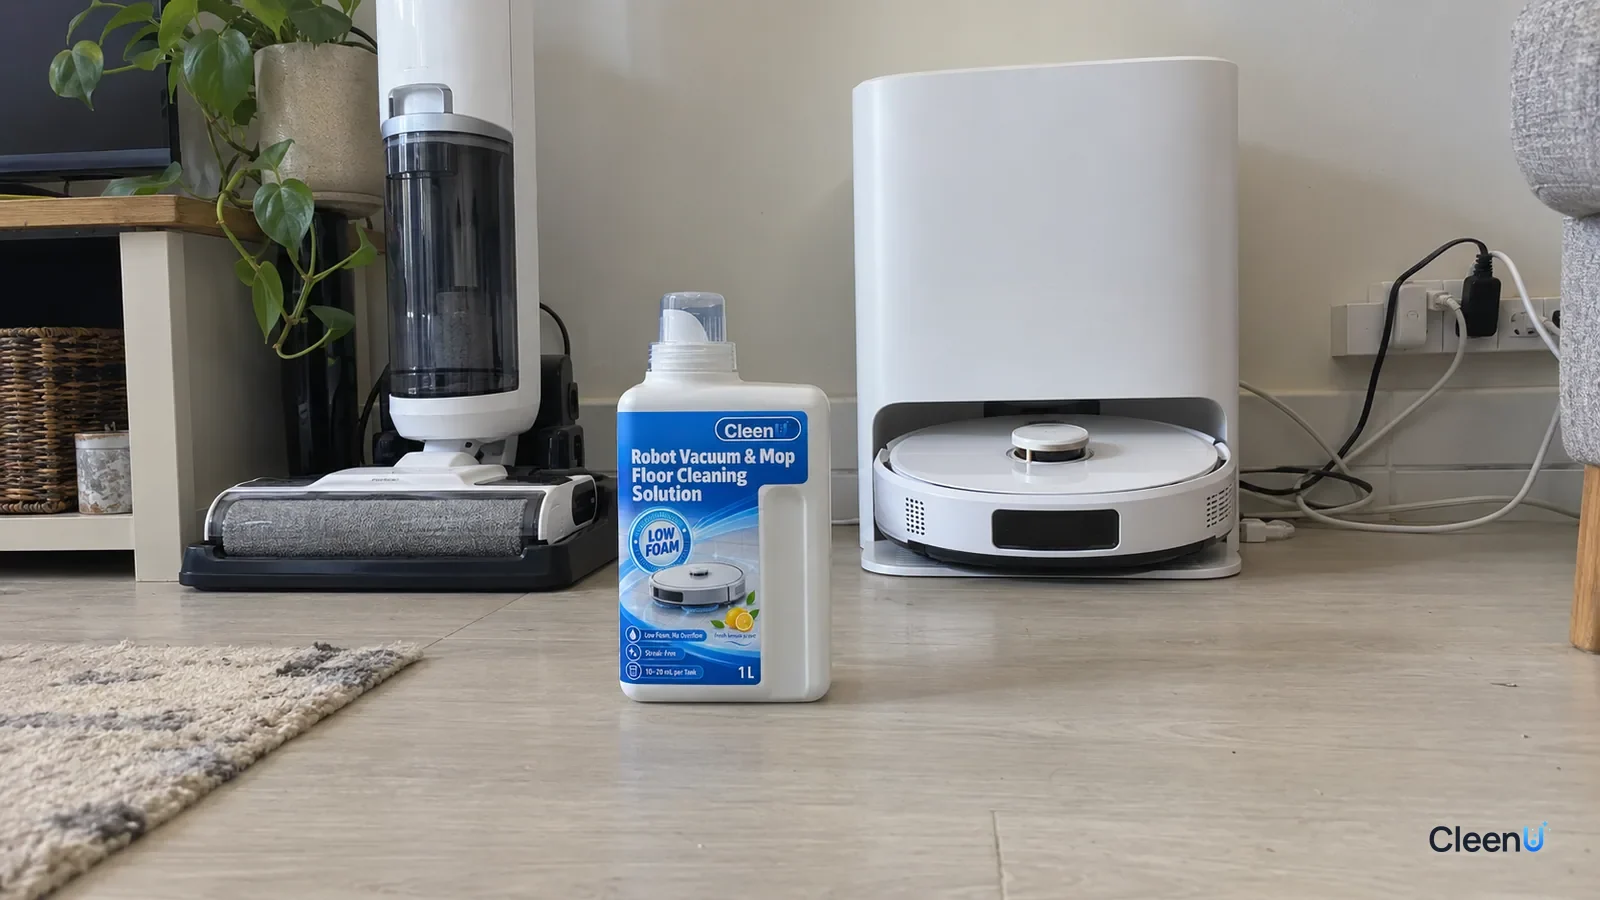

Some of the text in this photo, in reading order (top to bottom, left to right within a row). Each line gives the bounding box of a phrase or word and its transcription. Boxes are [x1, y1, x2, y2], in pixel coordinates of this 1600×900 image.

[631, 447, 795, 468] Robot Vacuum & Mop
[632, 467, 748, 486] Floor Cleaning
[632, 485, 702, 502] Solution
[648, 527, 675, 543] LOW
[645, 540, 680, 557] FOAM
[674, 669, 684, 677] per
[684, 668, 697, 676] Tank
